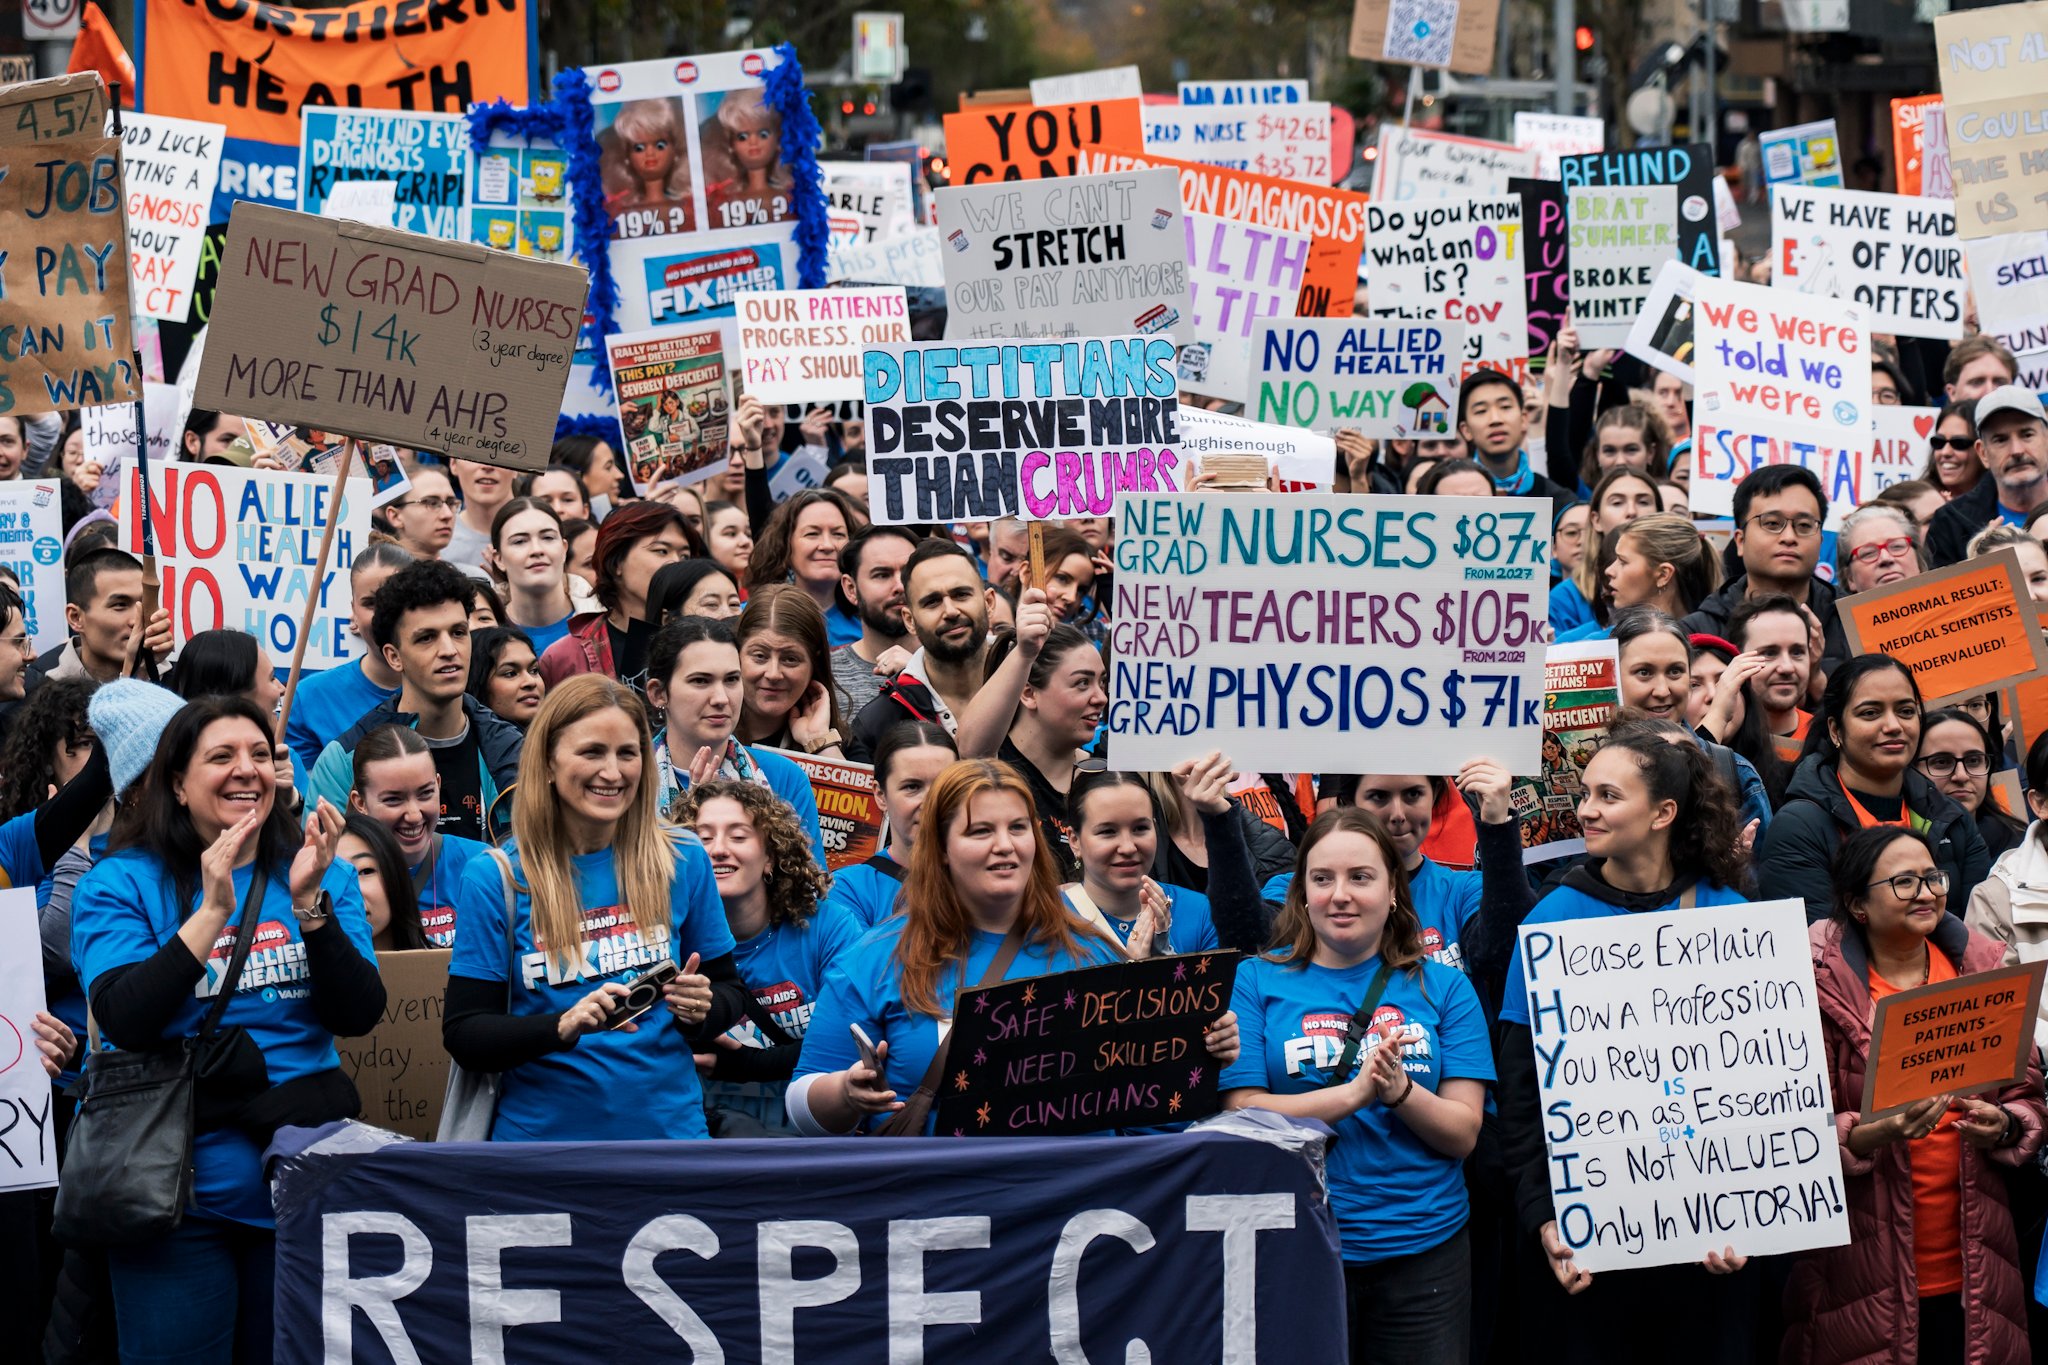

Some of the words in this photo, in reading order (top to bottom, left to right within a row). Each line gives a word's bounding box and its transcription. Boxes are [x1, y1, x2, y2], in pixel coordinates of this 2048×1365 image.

[1948, 34, 2012, 73] NOT
[17, 91, 98, 141] 4.5%
[335, 115, 425, 146] BEHIND
[986, 103, 1100, 161] YOU
[1195, 121, 1248, 144] NURSE
[159, 130, 211, 159] LUCK
[313, 139, 425, 173] DIAGNOSIS
[25, 155, 120, 220] JOB
[186, 170, 199, 190] A
[1561, 148, 1692, 196] BEHIND
[1951, 154, 2009, 185] THE
[616, 208, 665, 239] 19%
[718, 198, 769, 228] 19%
[960, 191, 1026, 234] WE
[1043, 180, 1137, 227] CAN'T
[1369, 206, 1405, 233] Do
[1408, 206, 1462, 240] you
[1468, 199, 1521, 222] know
[1576, 196, 1650, 221] BRAT
[1781, 197, 1815, 223] WE
[1830, 203, 1891, 231] HAVE
[1907, 211, 1955, 237] HAD
[992, 224, 1127, 272] STRETCH
[1442, 239, 1473, 264] an
[1475, 224, 1521, 261] OT
[1570, 223, 1672, 247] SUMMER
[36, 241, 114, 297] PAY
[681, 266, 707, 278] MORE
[707, 259, 733, 273] BAND
[733, 256, 755, 267] AIDS
[716, 266, 776, 293] ALLIED
[1573, 266, 1652, 288] BROKE
[1852, 241, 1891, 270] OF
[1901, 242, 1963, 280] YOUR
[146, 288, 182, 314] CT
[245, 237, 338, 298] NEW
[346, 253, 460, 315] GRAD
[472, 285, 578, 340] NURSES
[650, 278, 717, 320] FIX
[954, 278, 1006, 315] OUR
[1014, 271, 1063, 310] PAY
[1072, 261, 1185, 305] ANYMORE
[1854, 284, 1960, 323] OFFERS
[746, 298, 800, 323] OUR
[809, 294, 905, 321] PATIENTS
[83, 315, 114, 350] IT
[614, 345, 645, 359] RALLY
[659, 337, 692, 352] BETTER
[692, 333, 712, 346] PAY
[742, 325, 856, 350] PROGRESS.
[862, 323, 907, 343] OUR
[1262, 328, 1320, 373] NO
[1336, 327, 1442, 353] ALLIED
[1770, 311, 1858, 354] were
[493, 340, 528, 368] year
[528, 346, 570, 372] degree)
[619, 369, 646, 383] THIS
[646, 362, 676, 378] PAY?
[648, 347, 700, 362] DIETITIANS!
[747, 356, 790, 385] PAY
[862, 338, 1177, 404] DIETITIANS
[1334, 354, 1445, 375] HEALTH
[1715, 338, 1789, 379] told
[1800, 357, 1843, 391] we
[43, 359, 136, 406] WAY?
[225, 353, 324, 401] MORE
[335, 367, 416, 415] THAN
[621, 378, 665, 399] SEVERELY
[666, 365, 719, 390] DEFICIENT!
[1729, 381, 1821, 421] were
[1257, 380, 1320, 428] NO
[1329, 389, 1396, 420] WAY
[871, 399, 1086, 454] DESERVE
[1090, 397, 1181, 447] MORE
[445, 432, 475, 453] year
[475, 436, 528, 459] degree)
[872, 451, 1020, 521] THAN
[1020, 447, 1179, 519] CRUMBS
[131, 466, 227, 560] NO
[1123, 499, 1204, 537] NEW
[1219, 507, 1438, 570] NURSES
[1117, 538, 1208, 576] GRAD
[1464, 567, 1496, 580] FROM
[1497, 567, 1533, 580] 2027
[238, 563, 336, 609] WAY
[1872, 594, 1949, 627] ABNORMAL
[1950, 578, 2004, 603] RESULT:
[244, 608, 350, 658] HOME
[1118, 584, 1197, 622] NEW
[1202, 588, 1422, 649] TEACHERS
[1879, 628, 1940, 654] MEDICAL
[1941, 605, 2014, 636] SCIENTISTS
[1113, 621, 1200, 659] GRAD
[1462, 650, 1497, 663] FROM
[1497, 650, 1526, 663] 2029
[1580, 662, 1604, 676] PAY
[1116, 660, 1197, 701] NEW
[1206, 662, 1431, 733] PHYSIOS
[1109, 700, 1201, 737] GRAD
[1544, 705, 1611, 730] DEFICIENT!
[1510, 787, 1528, 801] FAIR
[1513, 796, 1531, 808] PAY
[257, 929, 285, 942] AIDS
[430, 913, 453, 927] AIDS
[586, 916, 617, 931] BAND
[599, 941, 671, 974] HEALTH
[1524, 931, 1645, 982] Please
[1656, 924, 1776, 968] Explain
[238, 959, 311, 991] HEALTH
[773, 989, 797, 1004] AIDS
[986, 1000, 1059, 1042] SAFE
[1081, 981, 1223, 1029] DECISIONS
[1620, 1001, 1639, 1031] A
[1652, 978, 1805, 1027] Profession
[1903, 998, 1980, 1027] ESSENTIAL
[1983, 989, 2015, 1008] FOR
[1304, 1021, 1319, 1030] NO
[1320, 1019, 1348, 1030] MORE
[1914, 1016, 1985, 1045] PATIENTS
[1004, 1050, 1076, 1087] NEED
[1607, 1044, 1661, 1084] Rely
[1672, 1042, 1710, 1073] on
[1719, 1027, 1809, 1072] Daily
[1901, 1040, 1977, 1070] ESSENTIAL
[1982, 1034, 2002, 1050] TO
[1930, 1063, 1965, 1084] PAY!
[384, 1088, 428, 1122] the
[1008, 1083, 1161, 1129] CLINICIANS
[1547, 1100, 1639, 1144] Seen
[1652, 1101, 1685, 1125] as
[1693, 1073, 1826, 1126] Essential
[1626, 1144, 1676, 1185] Not
[1685, 1126, 1820, 1176] VALUED
[1559, 1202, 1645, 1256] Only
[1654, 1199, 1678, 1240] In
[1683, 1174, 1845, 1236] VICTORIA!
[320, 1191, 1297, 1365] RESPECT
